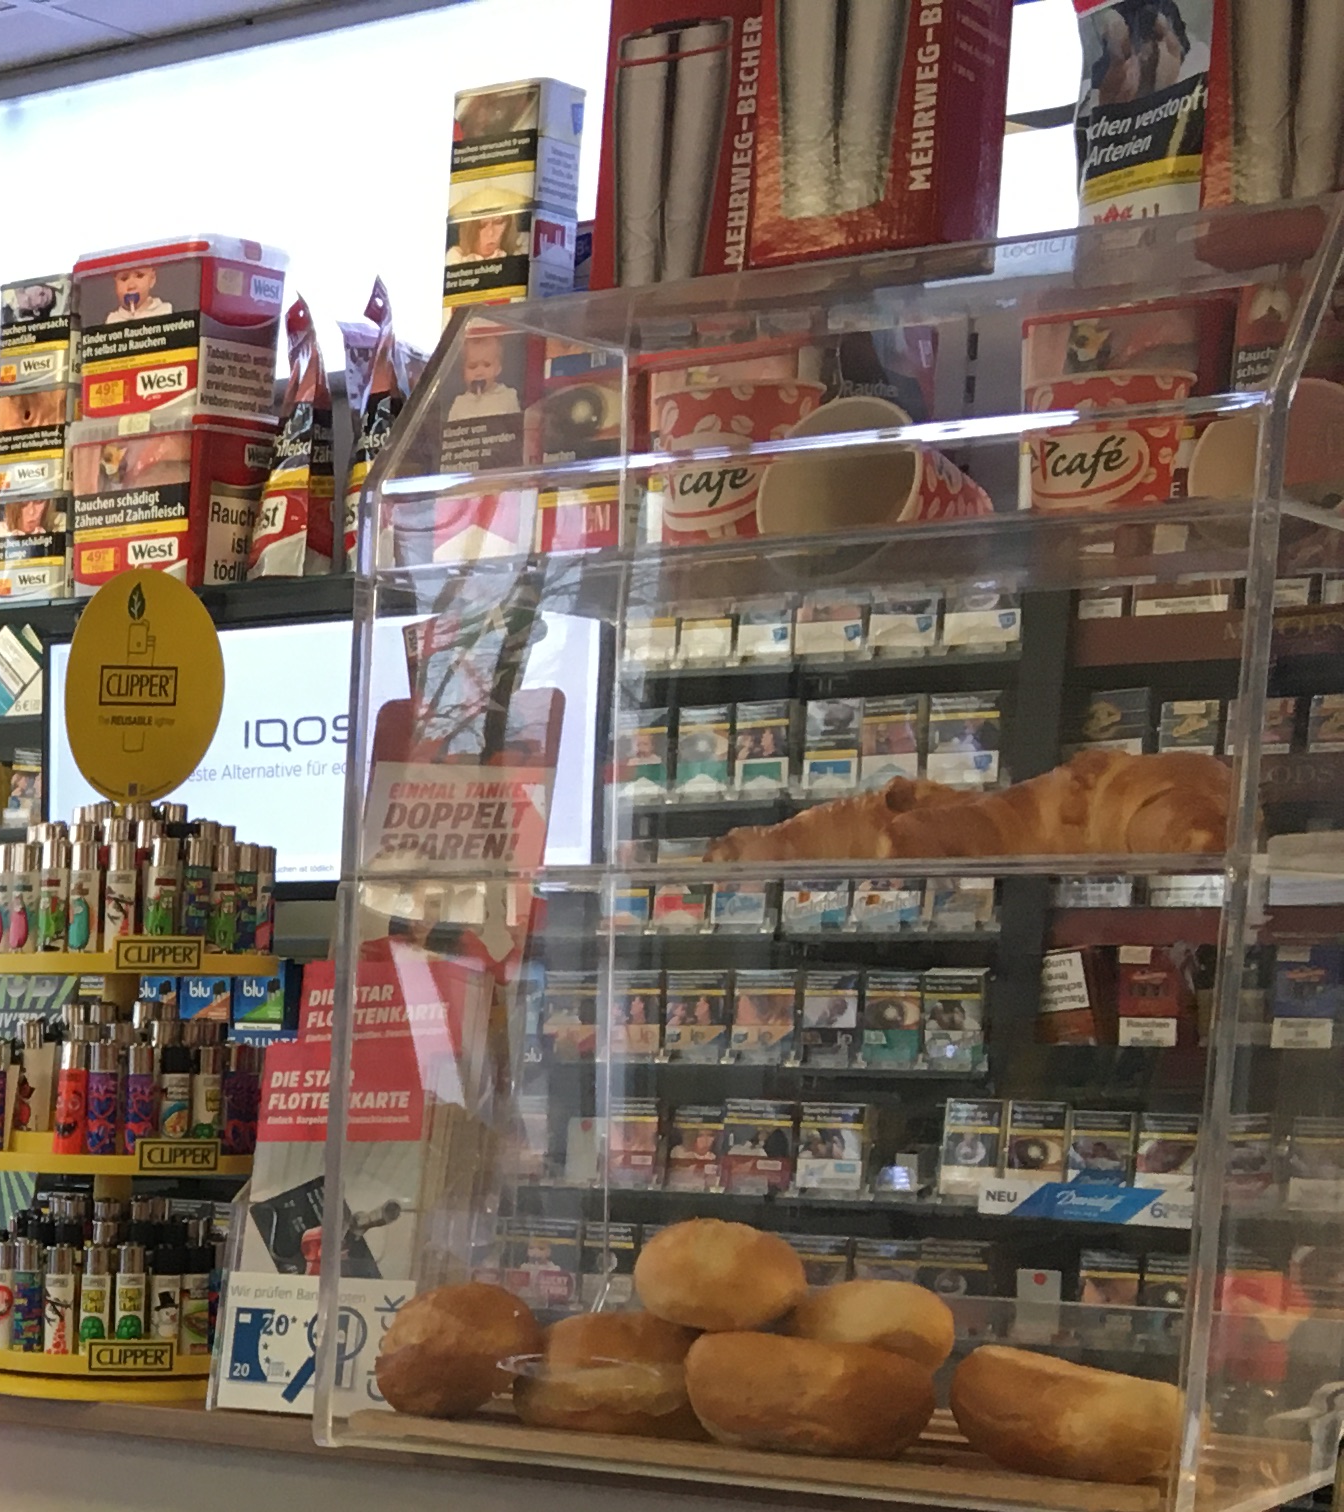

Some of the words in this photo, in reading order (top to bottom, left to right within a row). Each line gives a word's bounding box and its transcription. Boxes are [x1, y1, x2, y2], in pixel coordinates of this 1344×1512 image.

[1133, 84, 1206, 125] verstopft
[724, 16, 763, 266] MEHRWEG-BECHER
[1088, 133, 1152, 165] Arterien
[254, 278, 281, 299] West
[28, 319, 69, 333] verursacht
[82, 331, 106, 346] Kinder
[107, 330, 122, 342] von
[124, 324, 162, 340] Rauchern
[162, 320, 194, 332] werden
[94, 342, 116, 354] selbst
[118, 341, 128, 352] zu
[128, 336, 166, 351] Rauchern
[22, 358, 51, 370] West
[140, 372, 184, 390] West
[1051, 434, 1131, 487] café
[17, 466, 45, 478] West
[75, 498, 114, 513] Rauchen
[116, 491, 160, 508] schädigt
[75, 516, 103, 528] Zähne
[105, 512, 123, 524] und
[125, 504, 185, 522] Zahnfleisch
[132, 541, 174, 560] West
[18, 574, 47, 586] West
[106, 673, 170, 698] CLIPPER
[188, 764, 217, 781] este
[221, 763, 302, 781] Alternative
[307, 760, 328, 777] für
[388, 781, 460, 799] EINMAL
[383, 802, 532, 830] DOPPELT
[374, 833, 520, 861] SPAREN!
[123, 945, 193, 965] CLIPPER
[189, 979, 211, 999] blu
[243, 978, 265, 997] blu
[270, 1069, 300, 1088] DIE
[268, 1091, 411, 1111] FLOTTEKARTE
[146, 1147, 212, 1166] CLIPPER
[985, 1190, 1018, 1203] NEU
[230, 1285, 250, 1297] Wir
[254, 1286, 292, 1299] prüfen
[261, 1313, 289, 1336] 20
[96, 1347, 166, 1367] CLIPPER
[232, 1363, 249, 1377] 20
